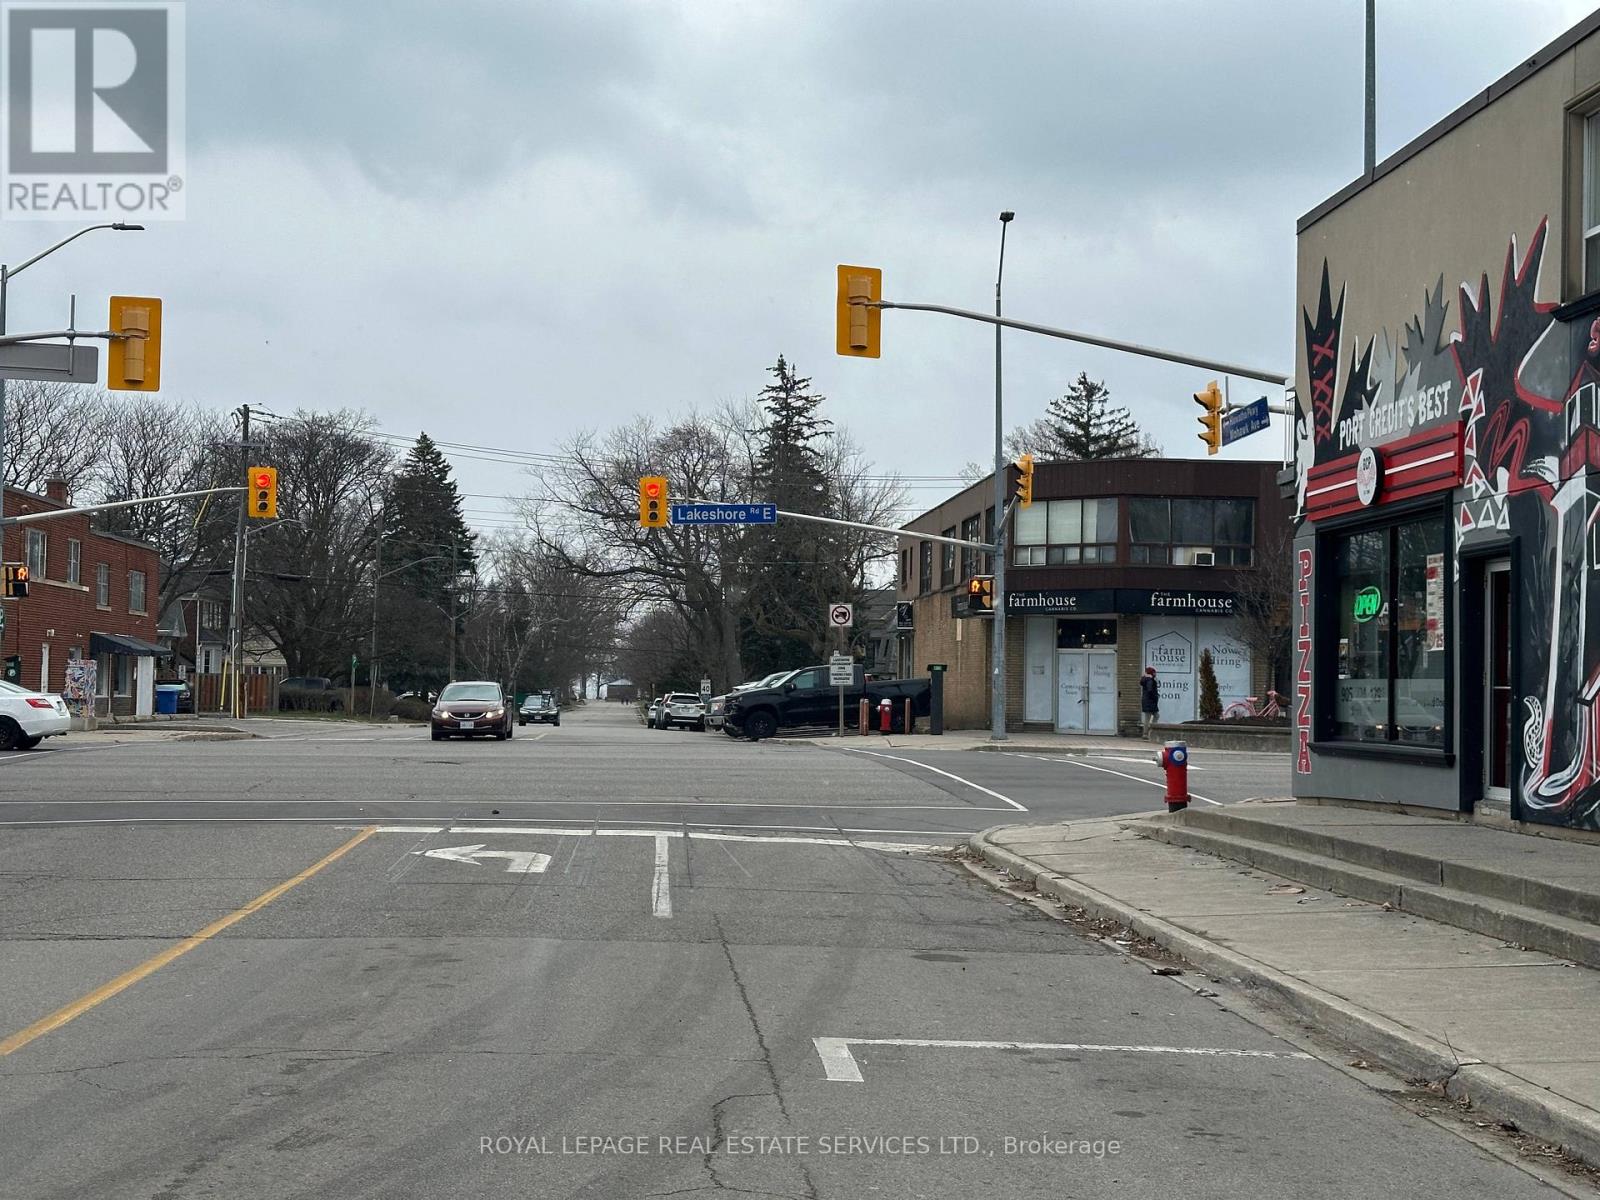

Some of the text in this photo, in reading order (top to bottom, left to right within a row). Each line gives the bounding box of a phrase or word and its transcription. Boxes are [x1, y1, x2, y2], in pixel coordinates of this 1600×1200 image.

[1339, 380, 1451, 451] PORT CREDIT'S BEST
[678, 508, 746, 520] Lakeshore
[763, 508, 772, 519] E
[1009, 593, 1077, 607] farmhouse
[1151, 592, 1233, 608] farmhouse
[1355, 594, 1377, 615] OPEN
[1152, 650, 1186, 662] house
[1158, 644, 1185, 656] farm
[1212, 645, 1237, 654] Now
[1297, 549, 1312, 774] PIZZA
[1158, 692, 1180, 700] oon
